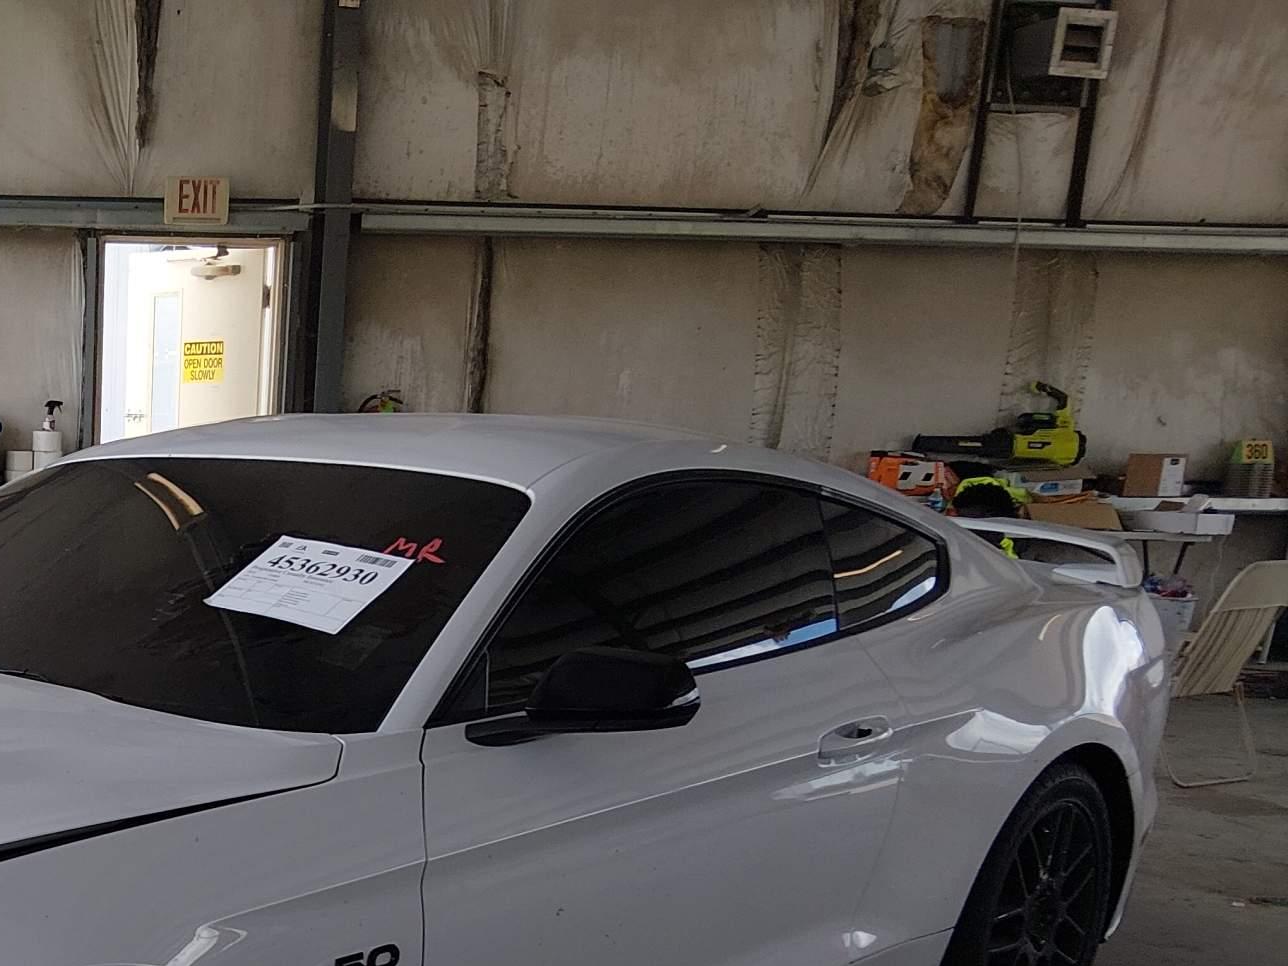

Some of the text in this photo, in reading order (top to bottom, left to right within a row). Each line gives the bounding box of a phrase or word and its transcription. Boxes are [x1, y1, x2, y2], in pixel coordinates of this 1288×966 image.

[178, 179, 221, 214] EXIT
[184, 342, 223, 355] CAUTION
[184, 357, 223, 369] OPEN DOOR
[190, 369, 216, 381] SLOWLY
[1245, 443, 1269, 460] 360
[267, 554, 379, 586] 45362930
